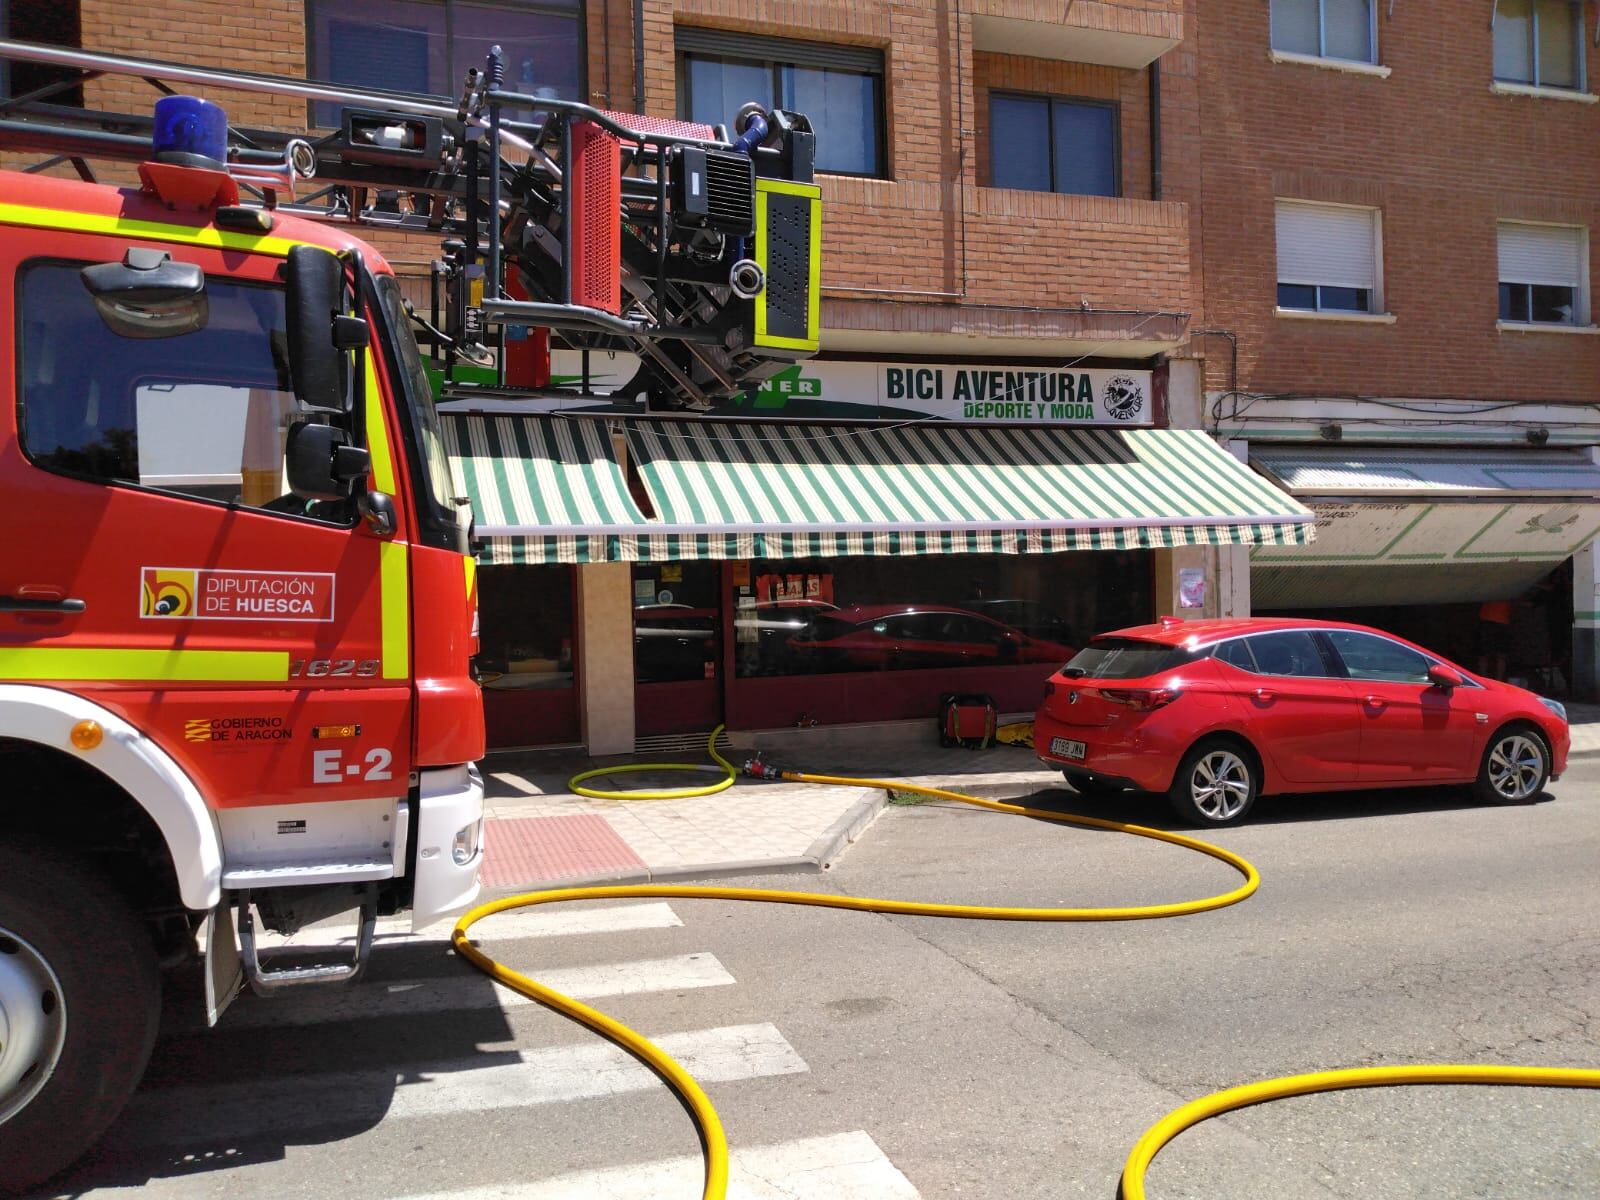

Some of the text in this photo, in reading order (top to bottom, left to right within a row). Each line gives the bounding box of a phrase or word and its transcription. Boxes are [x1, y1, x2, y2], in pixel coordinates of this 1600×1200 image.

[886, 367, 1094, 403] BICI AVENTURA
[963, 401, 1095, 420] DEPORTE Y MODA
[206, 577, 315, 596] DIPUTACIÓN
[205, 597, 314, 614] DE HUESCA
[291, 658, 380, 678] 1629
[211, 717, 282, 729] GOBIERNO
[211, 728, 292, 741] DE ARAGON
[313, 747, 393, 784] E-2
